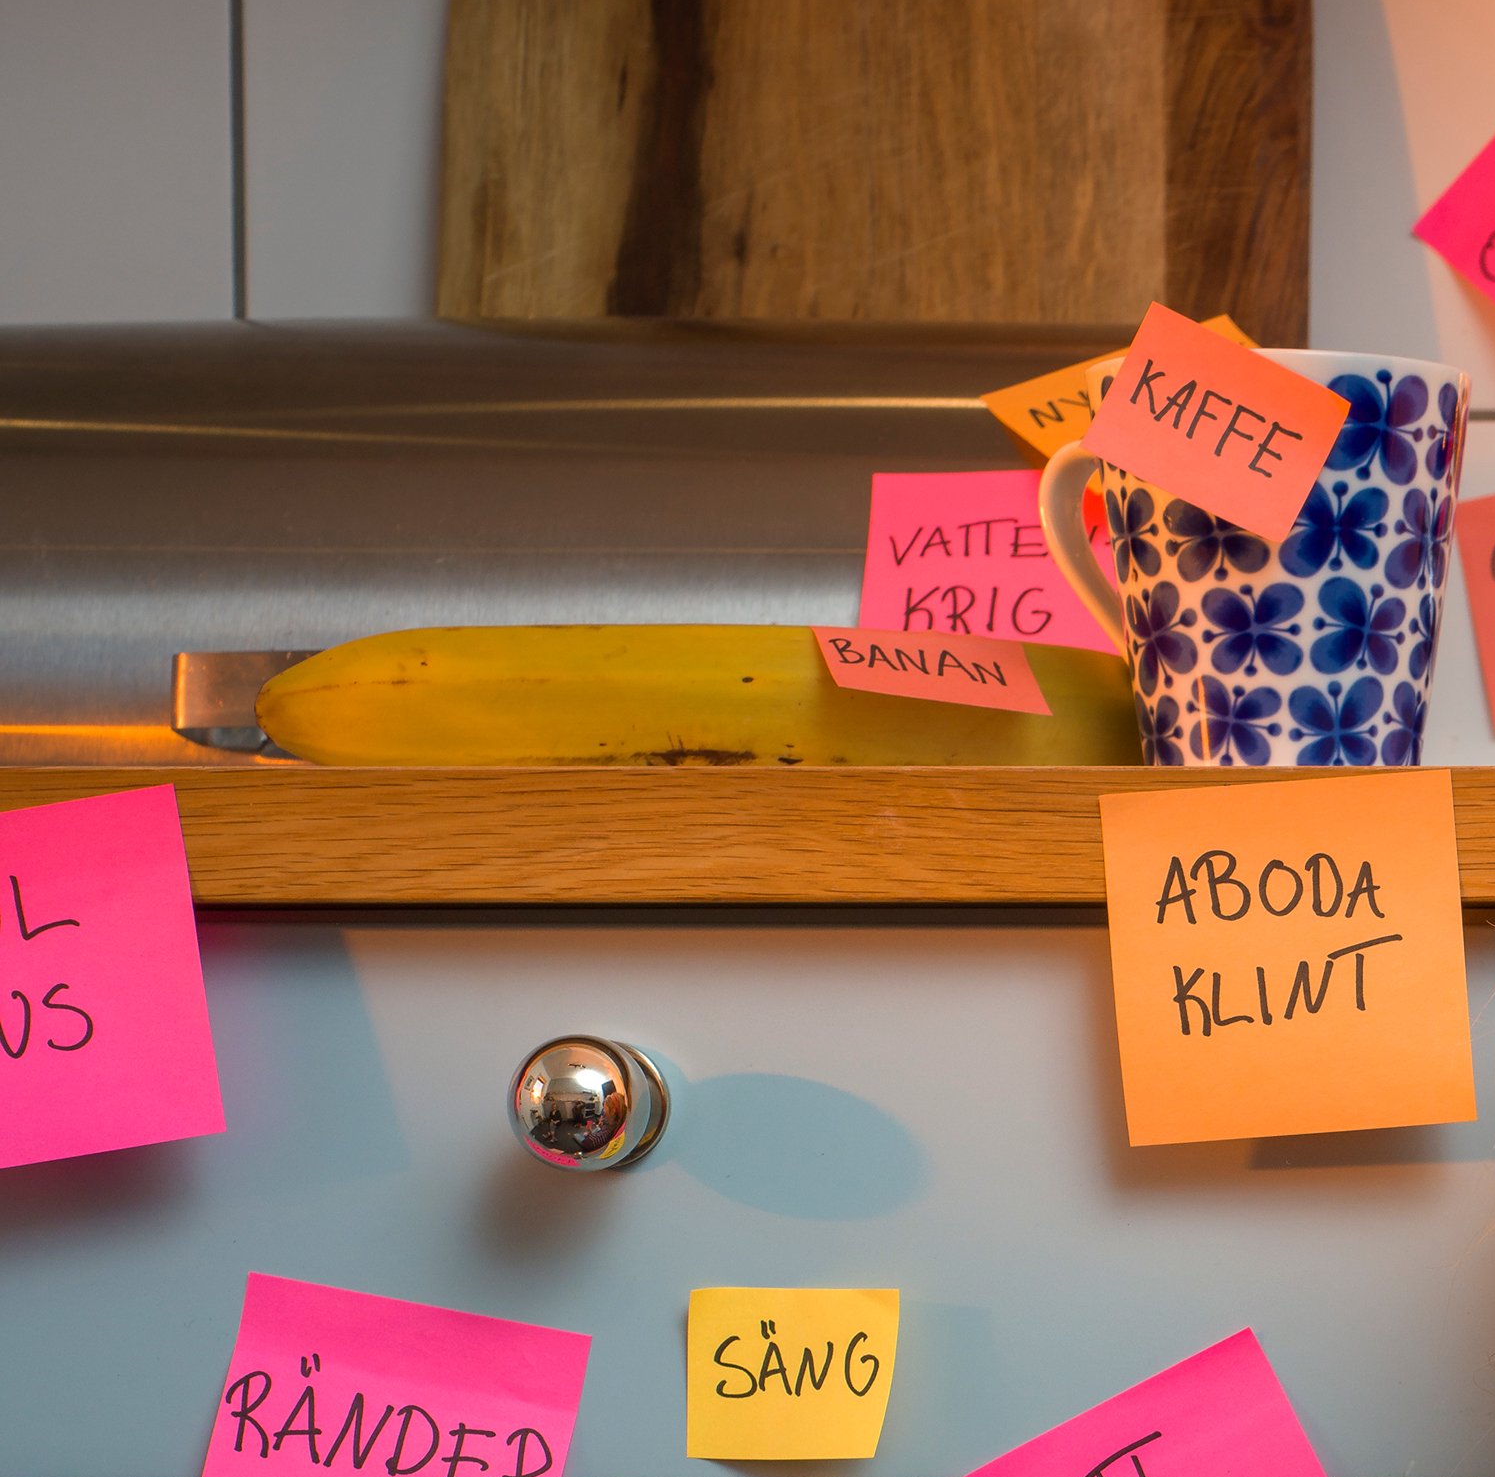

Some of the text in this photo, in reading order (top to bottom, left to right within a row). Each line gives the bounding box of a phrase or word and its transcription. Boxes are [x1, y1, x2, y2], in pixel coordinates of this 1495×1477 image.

[1132, 359, 1302, 477] KAFFE
[904, 586, 1052, 635] KRIG
[828, 637, 1008, 687] BANAN
[1156, 850, 1386, 924] ABODA
[1172, 934, 1402, 1036] KLINT
[713, 1320, 880, 1398] SÄNG
